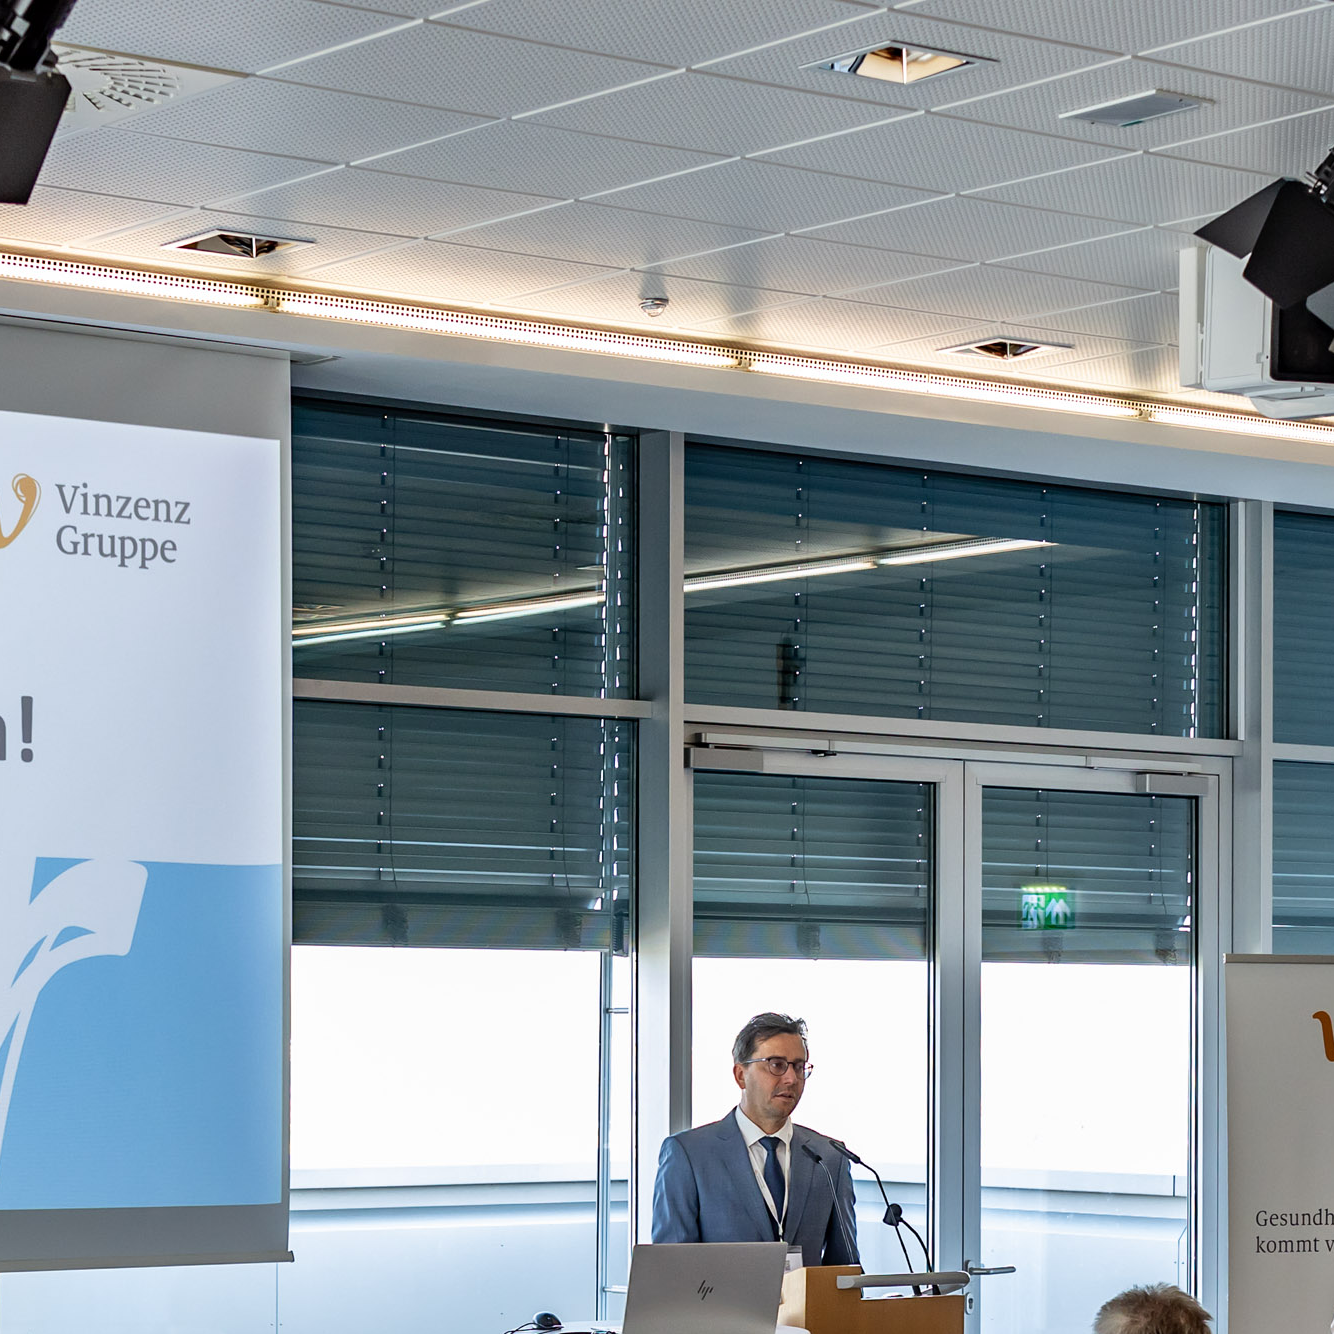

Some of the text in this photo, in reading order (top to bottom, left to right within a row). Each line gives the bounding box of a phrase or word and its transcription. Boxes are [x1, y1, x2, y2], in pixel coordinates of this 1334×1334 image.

[54, 482, 192, 526] Vinzenz
[55, 524, 178, 570] Gruppe
[1255, 1235, 1320, 1254] kommt
